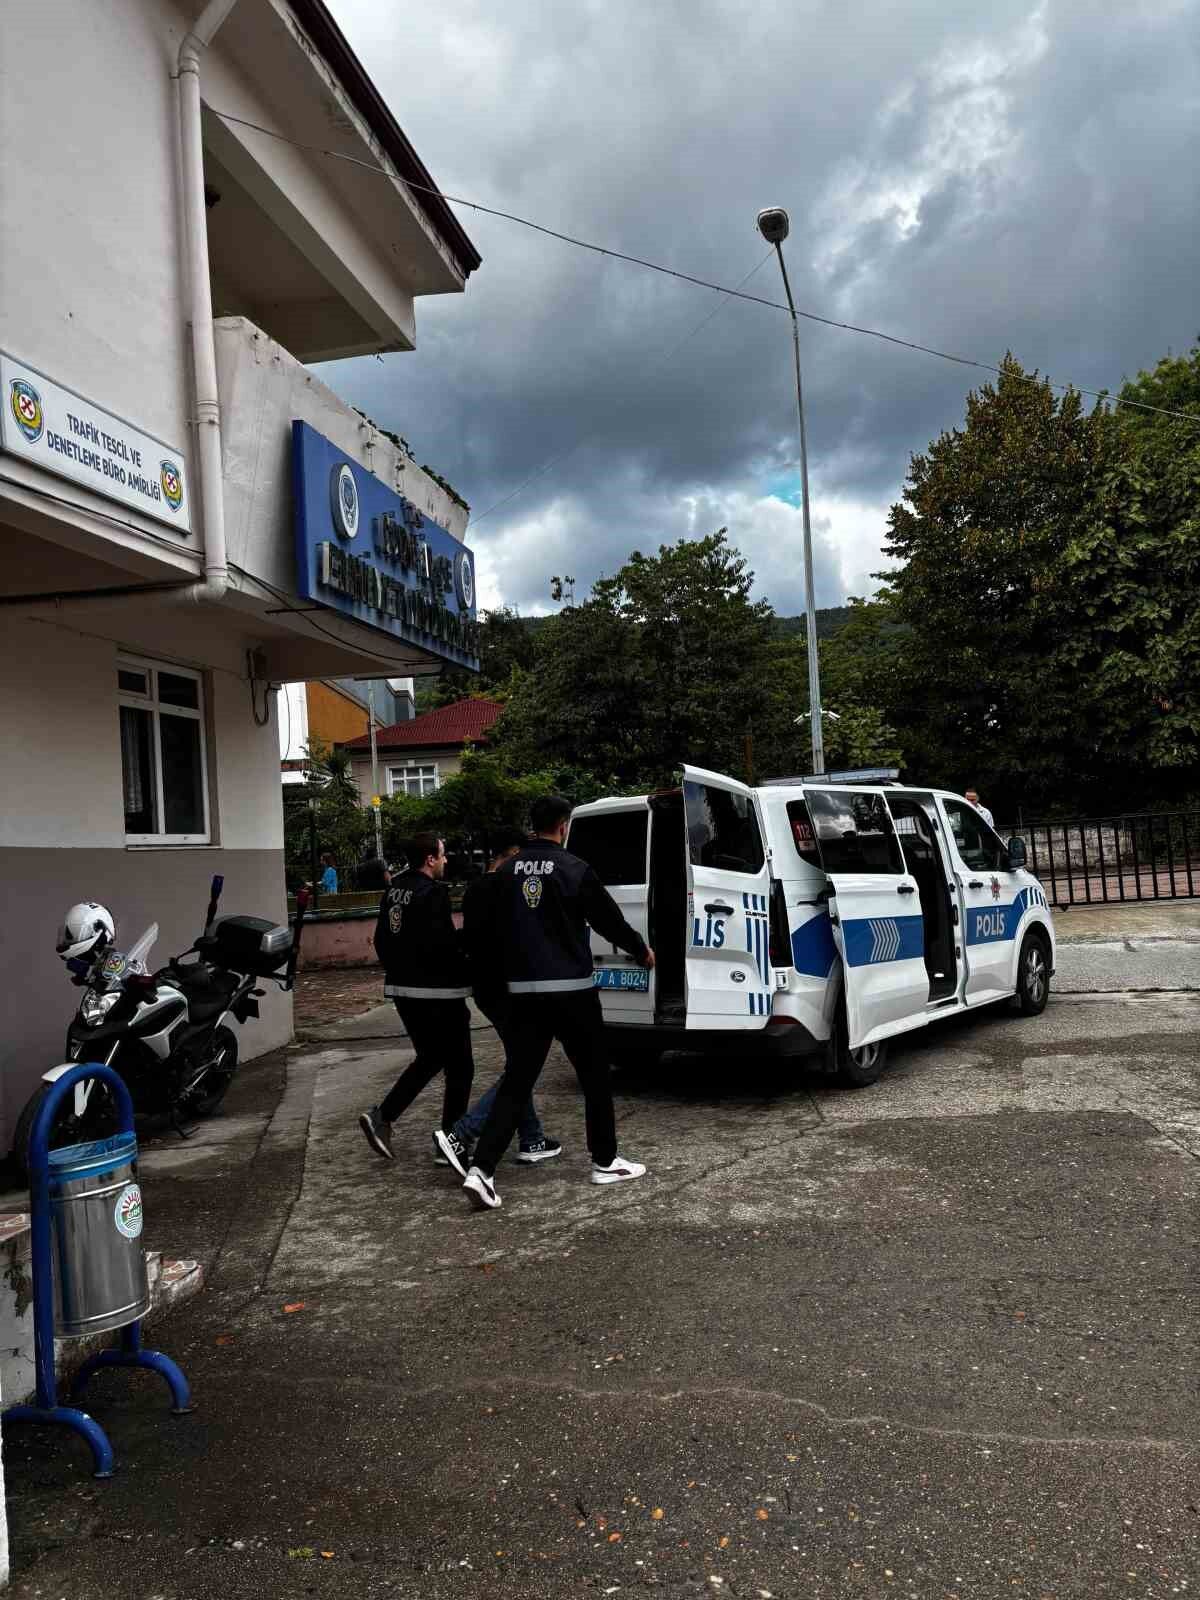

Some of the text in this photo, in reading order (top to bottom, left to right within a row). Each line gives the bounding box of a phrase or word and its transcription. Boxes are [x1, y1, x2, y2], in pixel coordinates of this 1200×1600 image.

[66, 413, 141, 467] TRAFİK TESCİL VE
[47, 430, 161, 501] DENETLEME BÜRO AMİRLİĞİ
[976, 907, 1005, 937] POLİS
[609, 971, 615, 985] A
[447, 1132, 465, 1155] EA7
